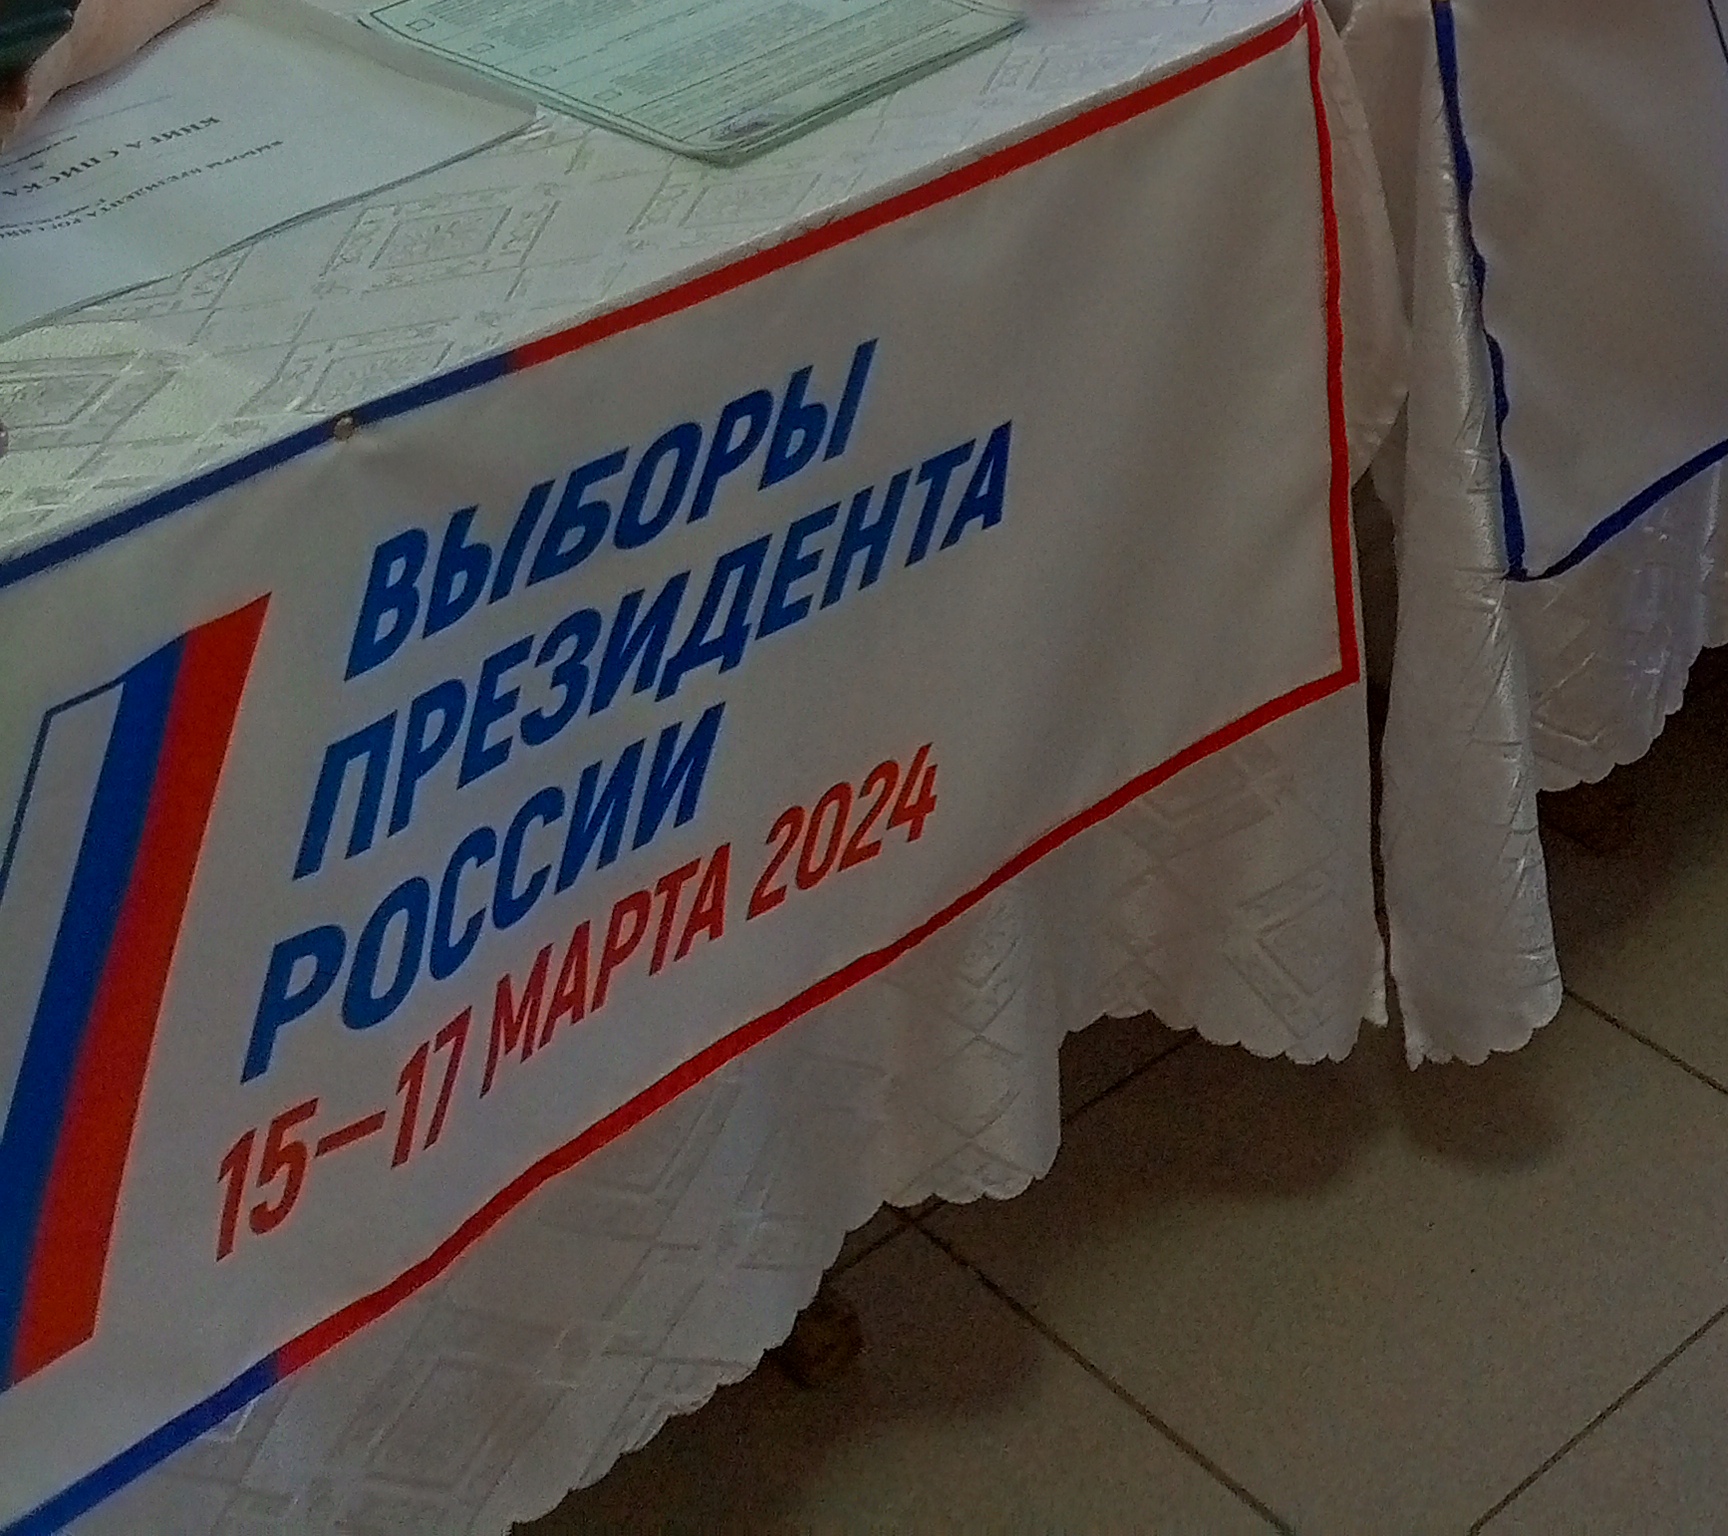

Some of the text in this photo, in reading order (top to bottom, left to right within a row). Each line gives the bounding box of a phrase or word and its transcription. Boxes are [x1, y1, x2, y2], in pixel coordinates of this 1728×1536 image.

[292, 420, 1013, 881] ПРЕЗИДЕНТА
[344, 338, 878, 681] ВЫБОРЫ
[240, 701, 726, 1085] РОССИИ
[478, 842, 732, 1097] МАРТА
[745, 743, 936, 920] 2024
